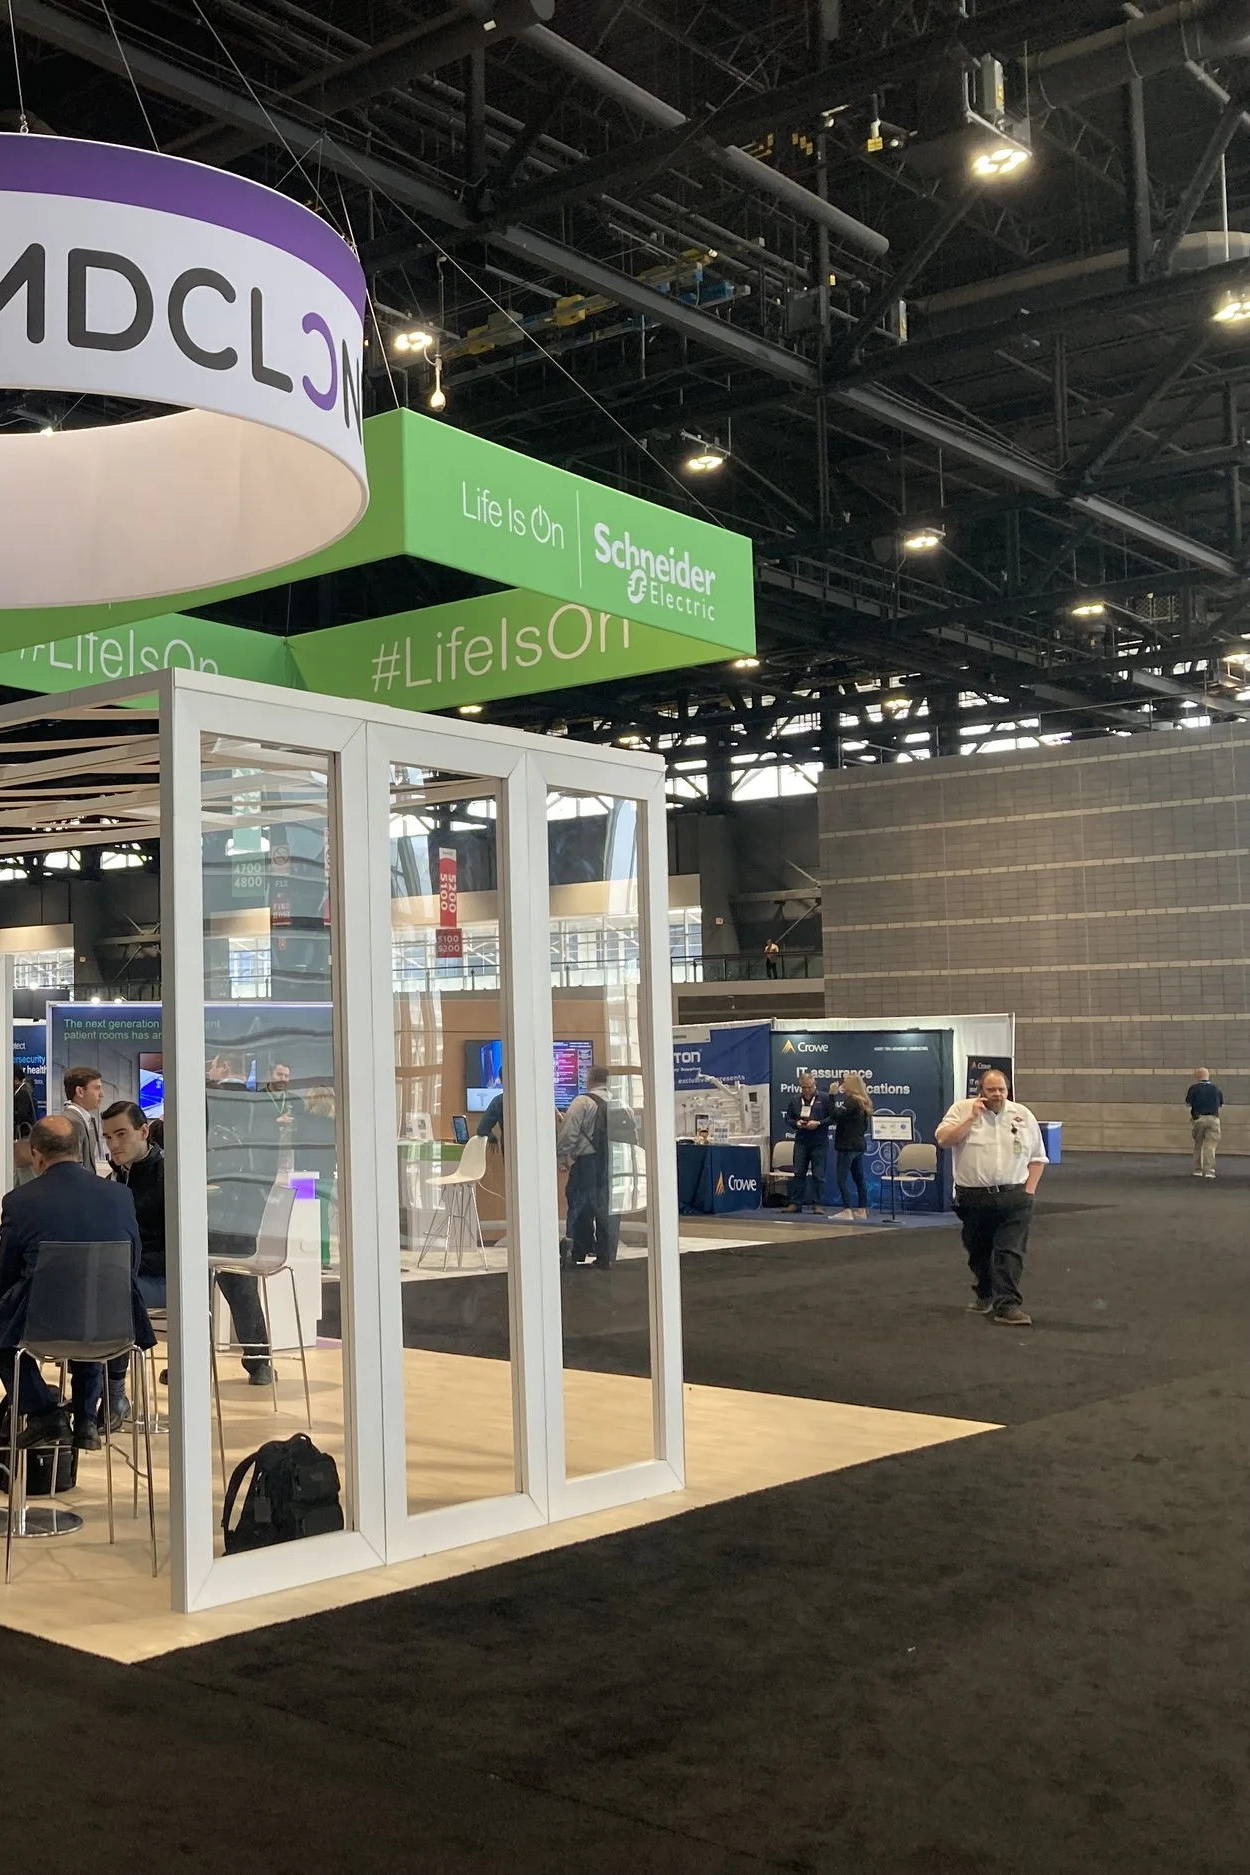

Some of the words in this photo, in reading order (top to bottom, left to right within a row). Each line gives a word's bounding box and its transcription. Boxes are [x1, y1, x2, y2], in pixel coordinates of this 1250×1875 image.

[462, 480, 502, 528] Life
[508, 497, 526, 536] Is
[530, 504, 565, 550] On
[594, 522, 716, 596] Schneider
[651, 580, 715, 622] Electric
[371, 603, 630, 693] #LifeIsOn
[233, 863, 262, 875] 4700
[233, 877, 263, 889] 4800
[440, 873, 448, 911] 5100
[448, 873, 457, 914] 5200
[64, 1019, 83, 1029] The
[85, 1019, 106, 1029] next
[108, 1018, 160, 1031] generation
[64, 1031, 96, 1041] patient
[99, 1032, 129, 1040] rooms
[132, 1030, 149, 1040] has
[797, 1041, 829, 1053] Crowe
[796, 1067, 808, 1079] IT
[811, 1068, 874, 1079] assurance
[728, 1174, 757, 1191] Crowe
